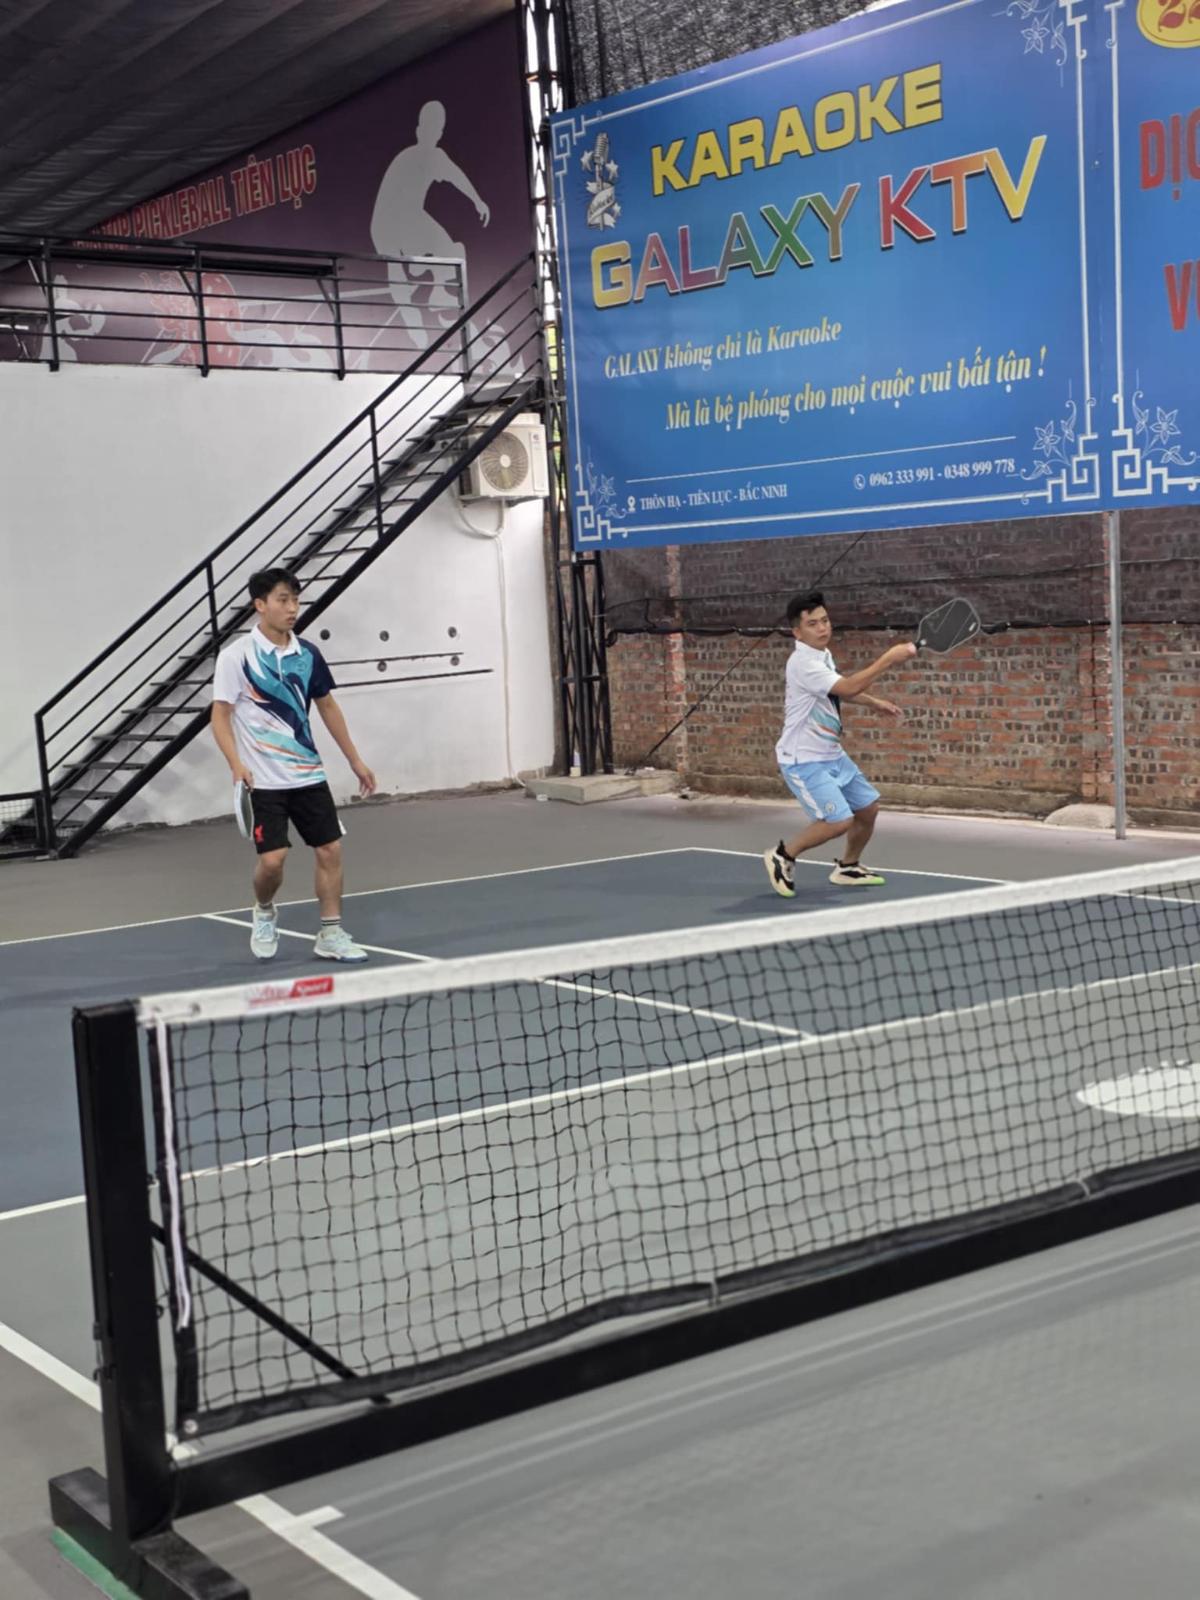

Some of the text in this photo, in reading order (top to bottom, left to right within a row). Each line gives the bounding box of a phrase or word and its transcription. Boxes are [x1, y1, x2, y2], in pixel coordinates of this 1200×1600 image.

[651, 62, 943, 196] KARAOKE
[133, 176, 231, 241] PICKLEBALL
[231, 154, 276, 217] TIÊN
[277, 144, 317, 209] LỤC
[590, 134, 1047, 310] GALAXY KTV
[604, 347, 662, 378] GALAXY
[665, 341, 713, 371] không
[746, 330, 762, 355] là
[767, 316, 842, 352] Karaoke
[665, 345, 1047, 432] Mà là bệ phóng cho mọi cuộc vui bất tận !
[640, 493, 666, 511] THÔN
[667, 495, 681, 511] HẠ
[688, 489, 711, 506] TIÊN
[711, 490, 731, 506] LỤC
[761, 484, 787, 498] NINH
[869, 471, 893, 487] 0962
[895, 469, 914, 484] 333
[916, 467, 935, 482] 991
[944, 463, 970, 479] 0348
[972, 461, 993, 476] 999
[994, 458, 1015, 473] 778
